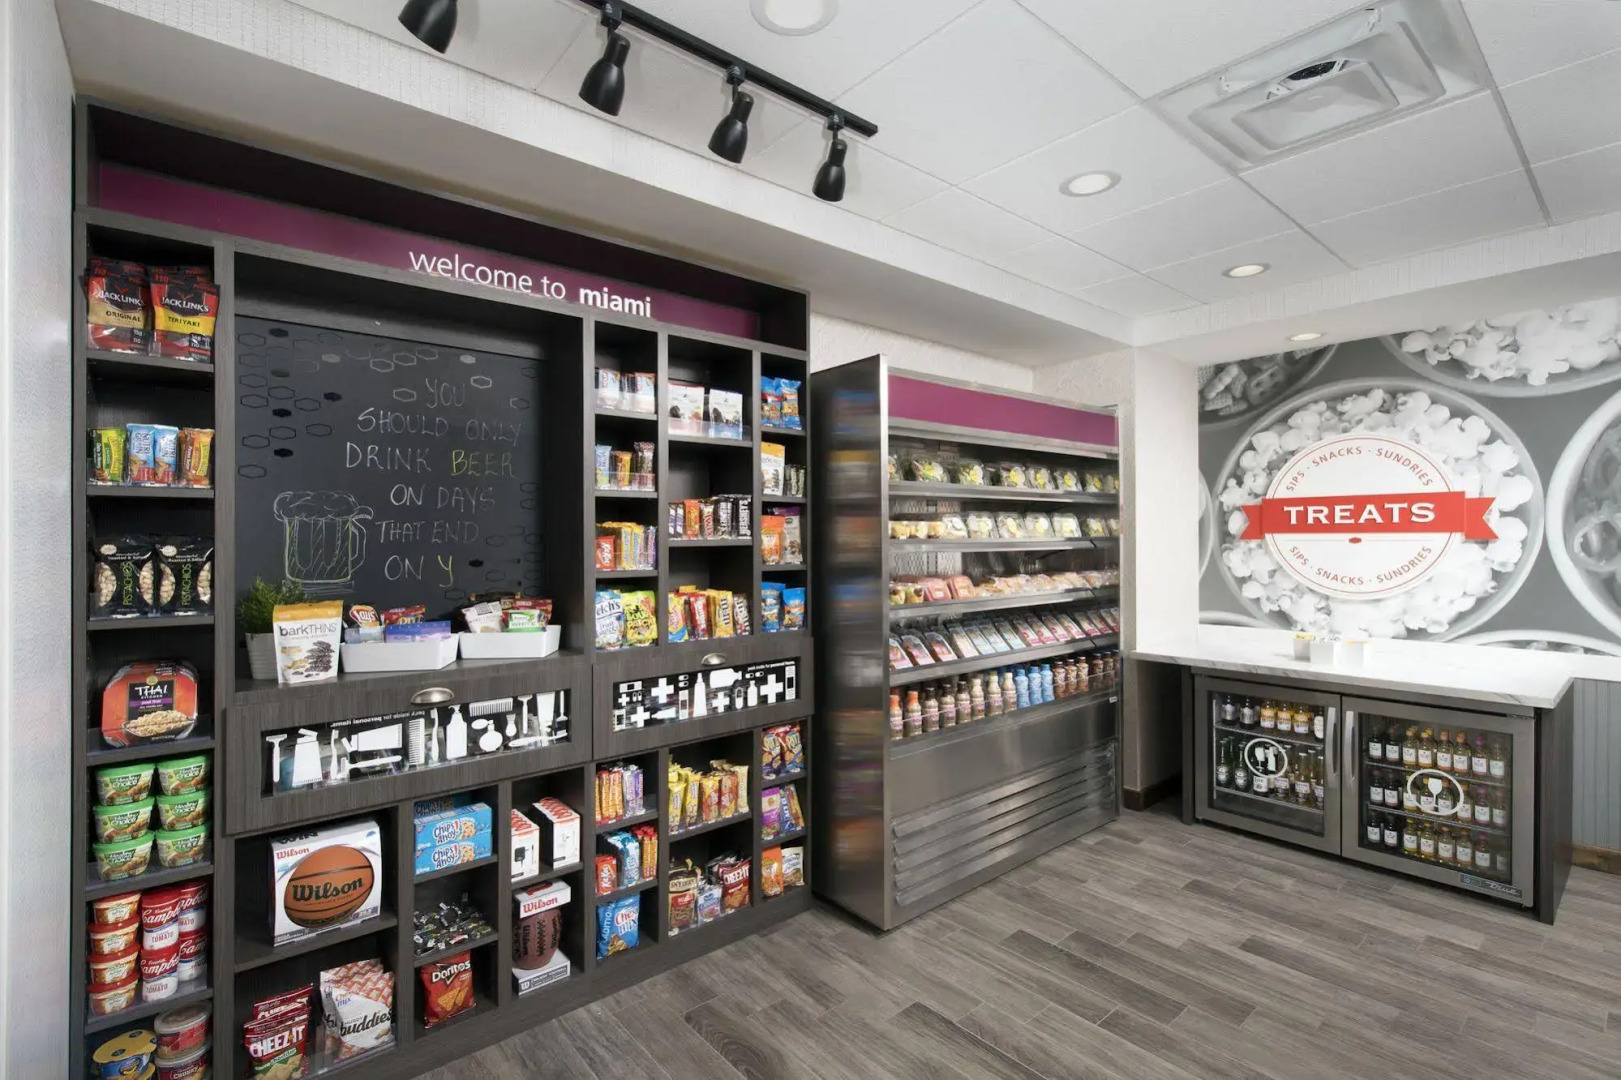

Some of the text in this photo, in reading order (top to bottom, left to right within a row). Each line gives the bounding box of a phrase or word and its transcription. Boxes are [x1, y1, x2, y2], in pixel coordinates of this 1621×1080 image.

[100, 290, 121, 301] JACK
[409, 251, 651, 318] welcome to miami
[162, 297, 182, 308] JACK
[106, 311, 142, 322] ORIGINAL
[168, 316, 200, 328] TERIYAKI
[425, 378, 466, 408] YOU
[357, 407, 524, 446] SHOULD ONLY
[346, 442, 516, 478] DRINK BEER
[1286, 446, 1434, 492] SIPS SNACKS SUNDRIES
[390, 483, 496, 514] ON DAYS
[1283, 502, 1436, 525] TREATS
[375, 520, 480, 544] THAT END
[384, 554, 453, 587] ON Y
[1289, 545, 1433, 586] SIPS SNACKS SUNDRIES
[123, 561, 133, 606] PISTACHIOS
[182, 562, 192, 606] PISTACHIOS
[596, 600, 621, 617] elch's
[280, 622, 337, 636] barkTHINS
[134, 684, 168, 697] THAI
[276, 847, 310, 860] Wilson
[292, 878, 363, 901] Wilson
[1489, 882, 1518, 896] True
[523, 897, 558, 914] Wilson
[614, 907, 639, 926] Chex
[152, 932, 174, 942] TOMATO
[432, 960, 471, 983] Doritos
[146, 984, 168, 994] TOMATO
[340, 1009, 393, 1037] buddies
